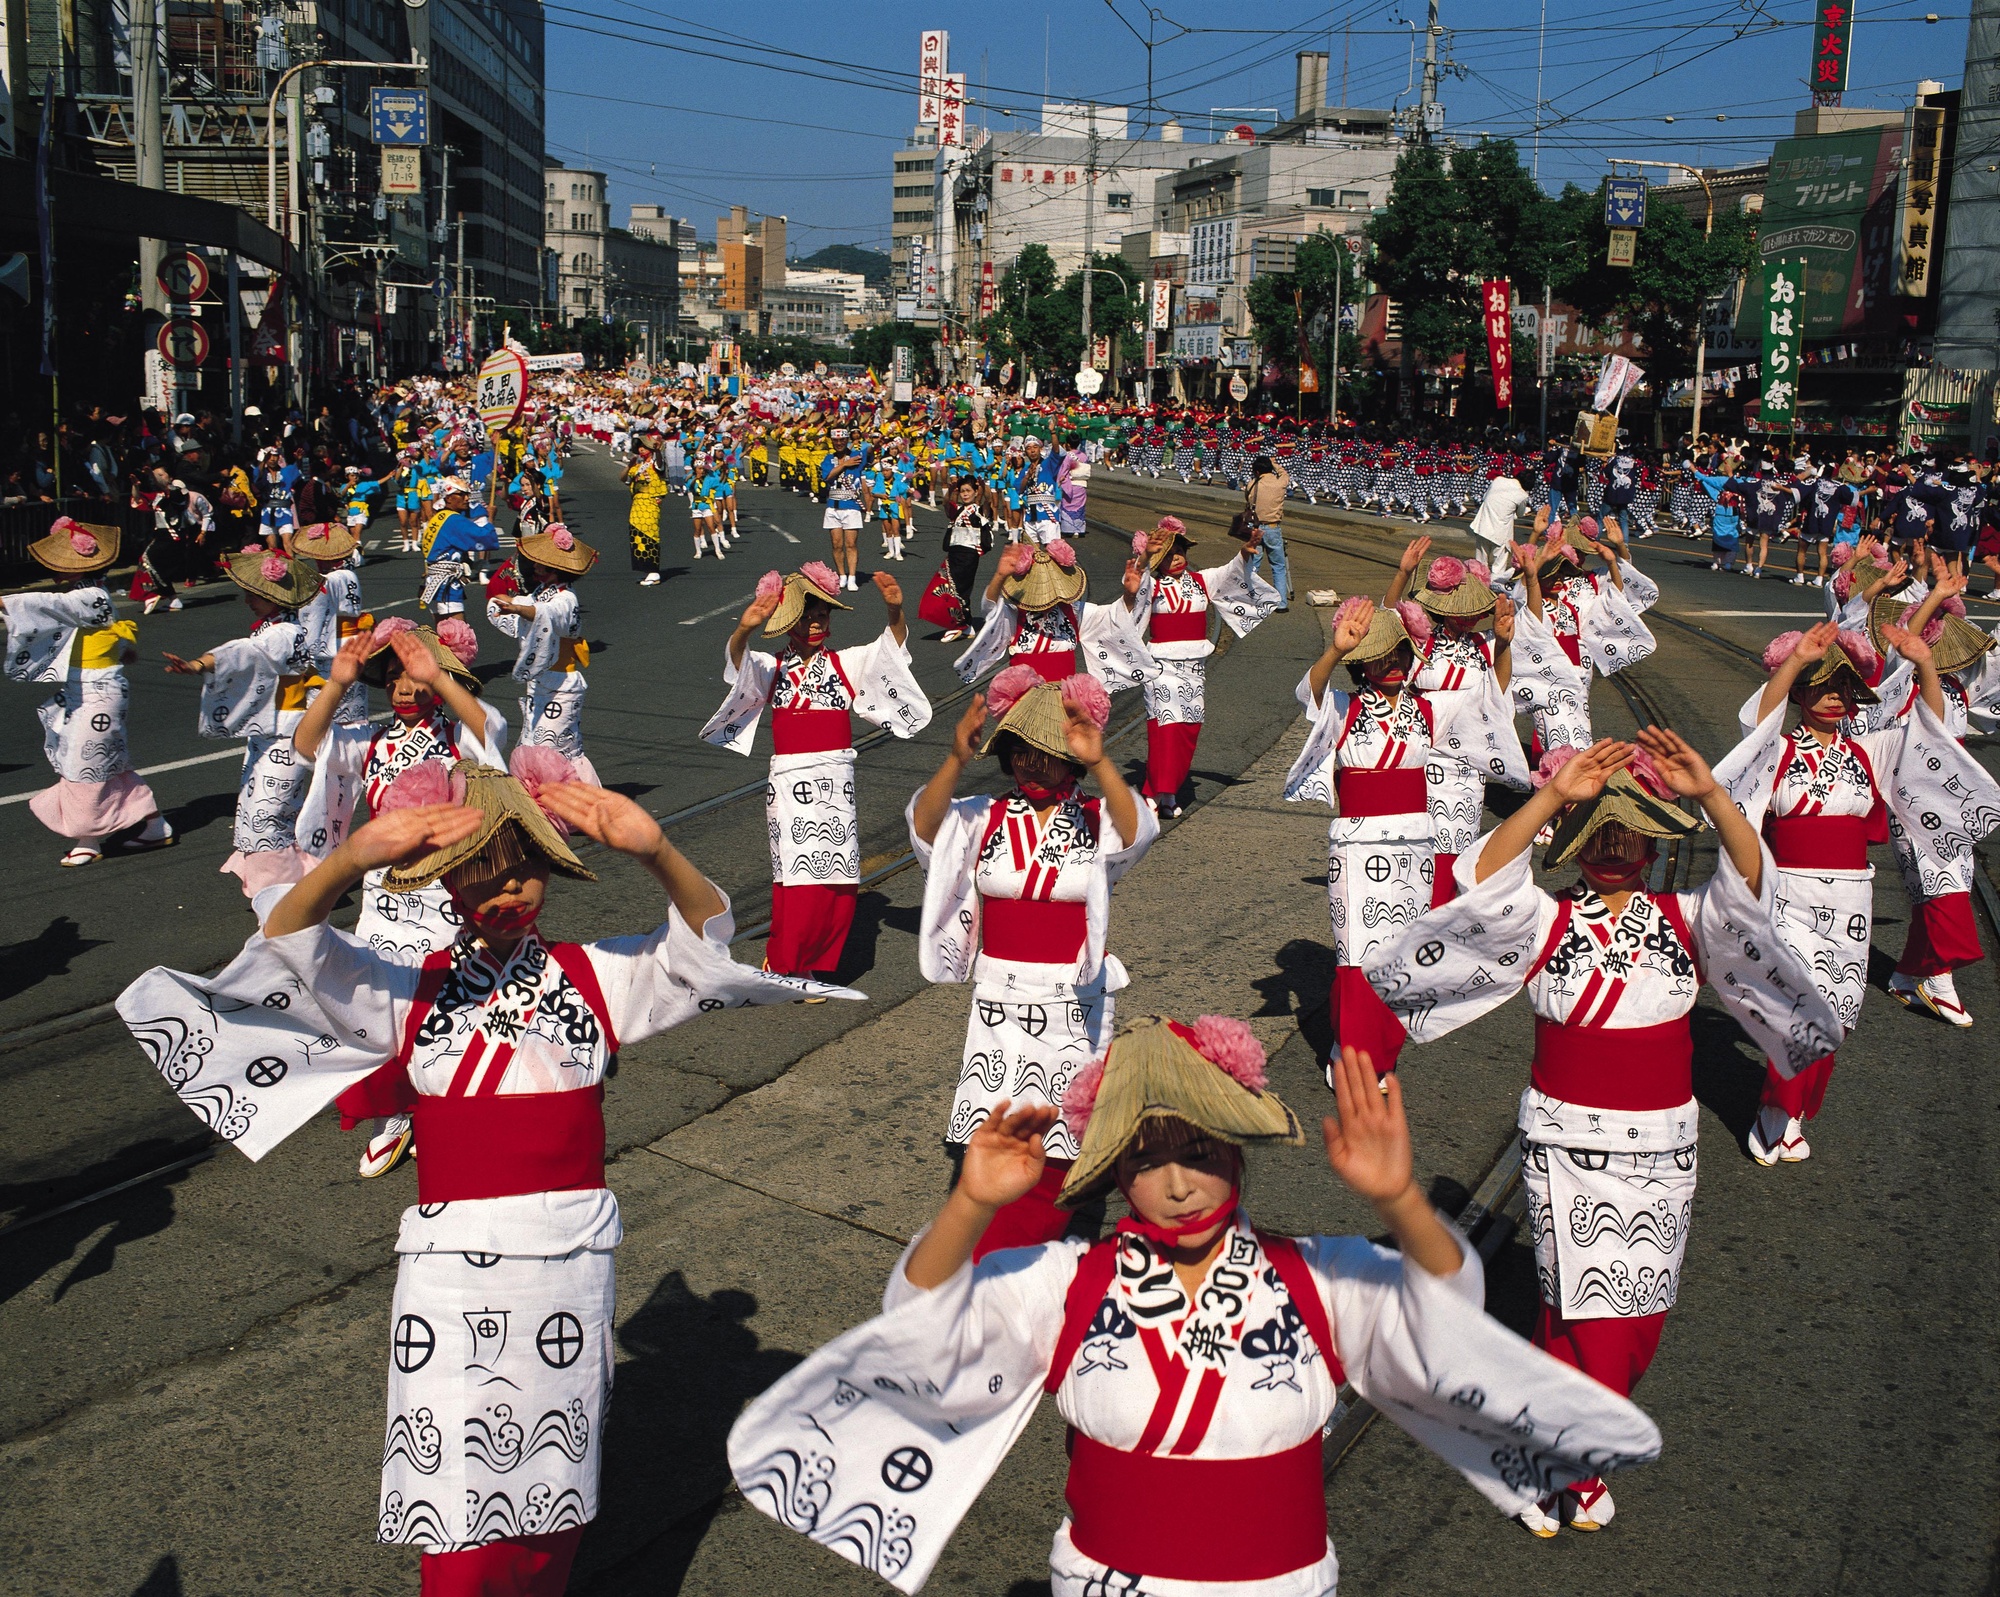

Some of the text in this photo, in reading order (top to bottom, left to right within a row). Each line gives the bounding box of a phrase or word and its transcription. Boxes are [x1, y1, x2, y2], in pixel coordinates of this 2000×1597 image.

[943, 78, 961, 145] 大和證券
[390, 173, 413, 182] 17-19
[392, 163, 412, 172] 7-9
[1775, 155, 1863, 182] フジカラー
[1795, 180, 1865, 207] プリント
[1905, 123, 1938, 282] 池田写真館
[1156, 282, 1168, 321] ラーメン
[1488, 286, 1511, 402] おはら祭
[1764, 272, 1795, 411] おはら祭
[479, 387, 517, 410] 文化協会
[484, 373, 511, 391] 西田
[1808, 747, 1845, 801] 第30回
[1038, 801, 1081, 865] 第30回
[1599, 895, 1654, 979] 第30回
[481, 939, 549, 1043] 第30回
[1181, 1233, 1257, 1368] 第30回
